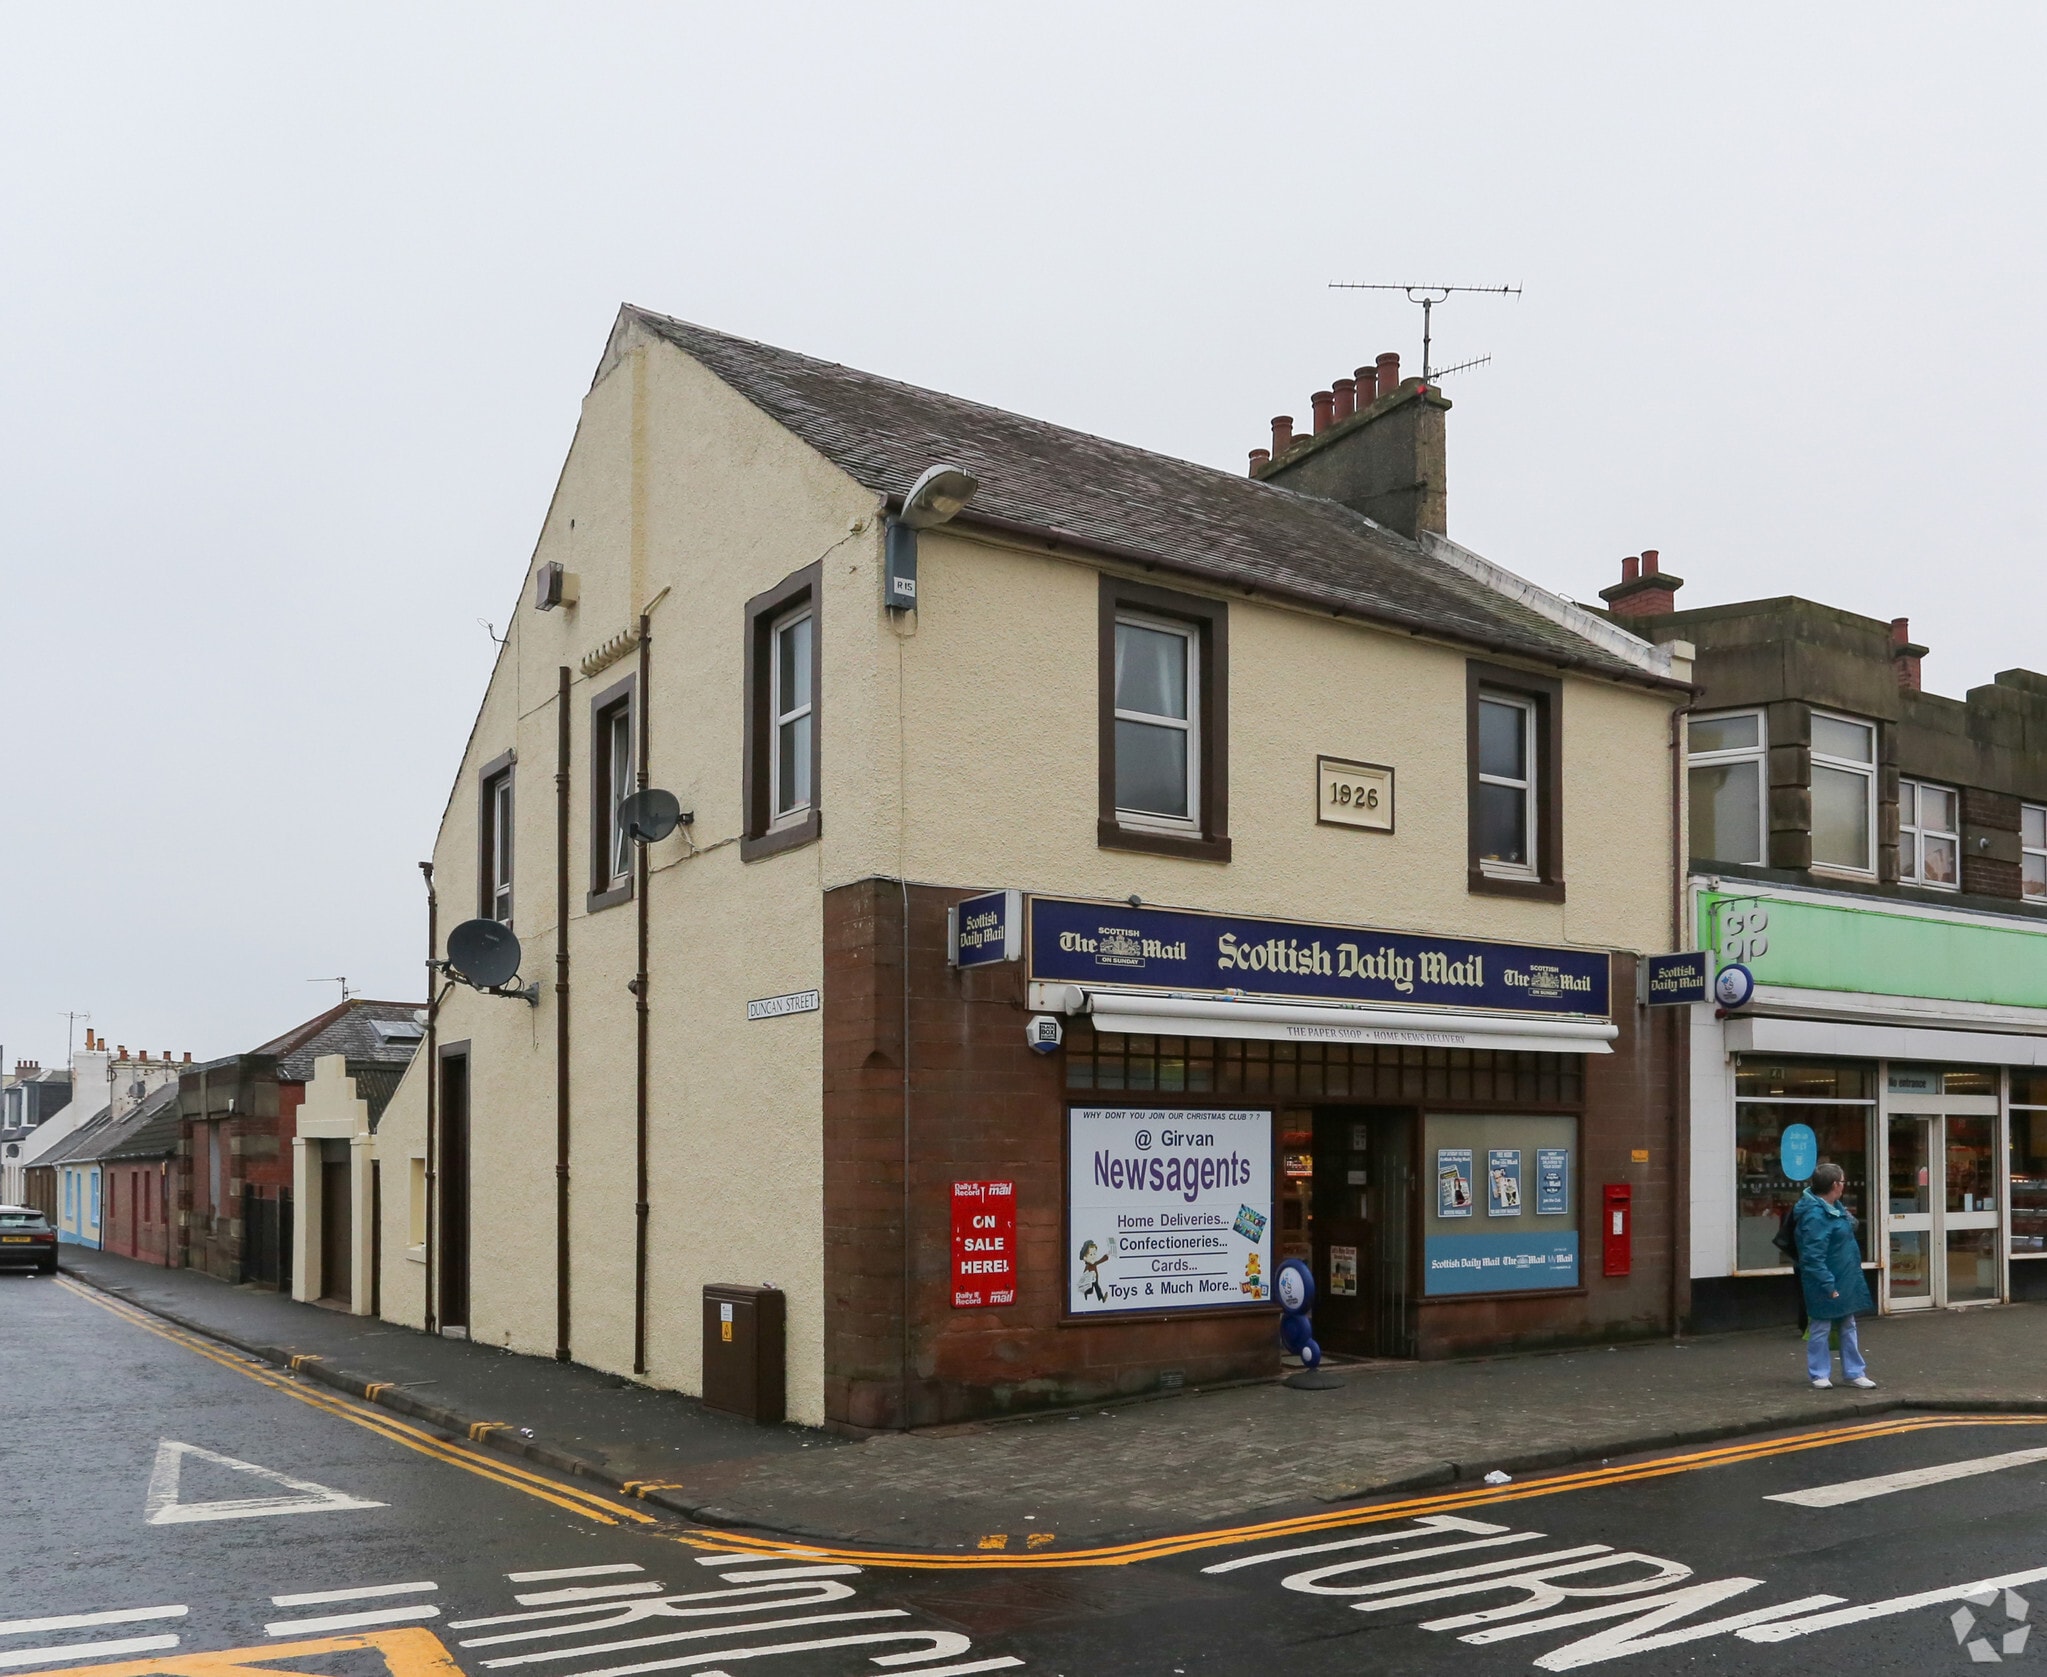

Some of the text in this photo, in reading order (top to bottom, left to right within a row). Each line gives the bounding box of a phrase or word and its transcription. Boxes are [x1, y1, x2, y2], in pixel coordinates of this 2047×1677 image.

[1330, 782, 1379, 809] 1926
[966, 911, 998, 930] Scottish
[960, 925, 1005, 948] Daily Mail
[1098, 927, 1140, 937] SCOTTISH
[1059, 931, 1187, 960] The Mail
[1112, 957, 1139, 965] SUNDAY
[1218, 932, 1484, 994] Scottish Daily Mail
[1529, 964, 1559, 973] SCOTTISH
[1504, 969, 1591, 991] The Mail
[1658, 965, 1696, 979] Scottish
[1651, 975, 1704, 992] Daily Mail
[750, 994, 815, 1017] DUNCAN STREET
[1287, 1026, 1466, 1044] THE PAPER SHOP HOME NEWS DELIVERY
[1148, 1112, 1165, 1120] JOIN
[1134, 1129, 1215, 1151] @ Girvan
[1094, 1149, 1251, 1203] Newsagents
[988, 1183, 1012, 1196] mail
[972, 1215, 996, 1228] ON
[1117, 1214, 1154, 1228] Home
[964, 1237, 1004, 1251] SALE
[961, 1260, 1009, 1274] HERE!
[1431, 1258, 1460, 1270] Scottish
[1460, 1256, 1481, 1270] Daily
[1482, 1257, 1500, 1267] Mail
[1502, 1256, 1517, 1266] The
[1528, 1255, 1546, 1264] Mail
[990, 1290, 1014, 1303] mail
[1108, 1284, 1139, 1300] Toys
[1145, 1283, 1154, 1295] &
[1160, 1281, 1193, 1295] Much
[1201, 1515, 1766, 1672] TURN
